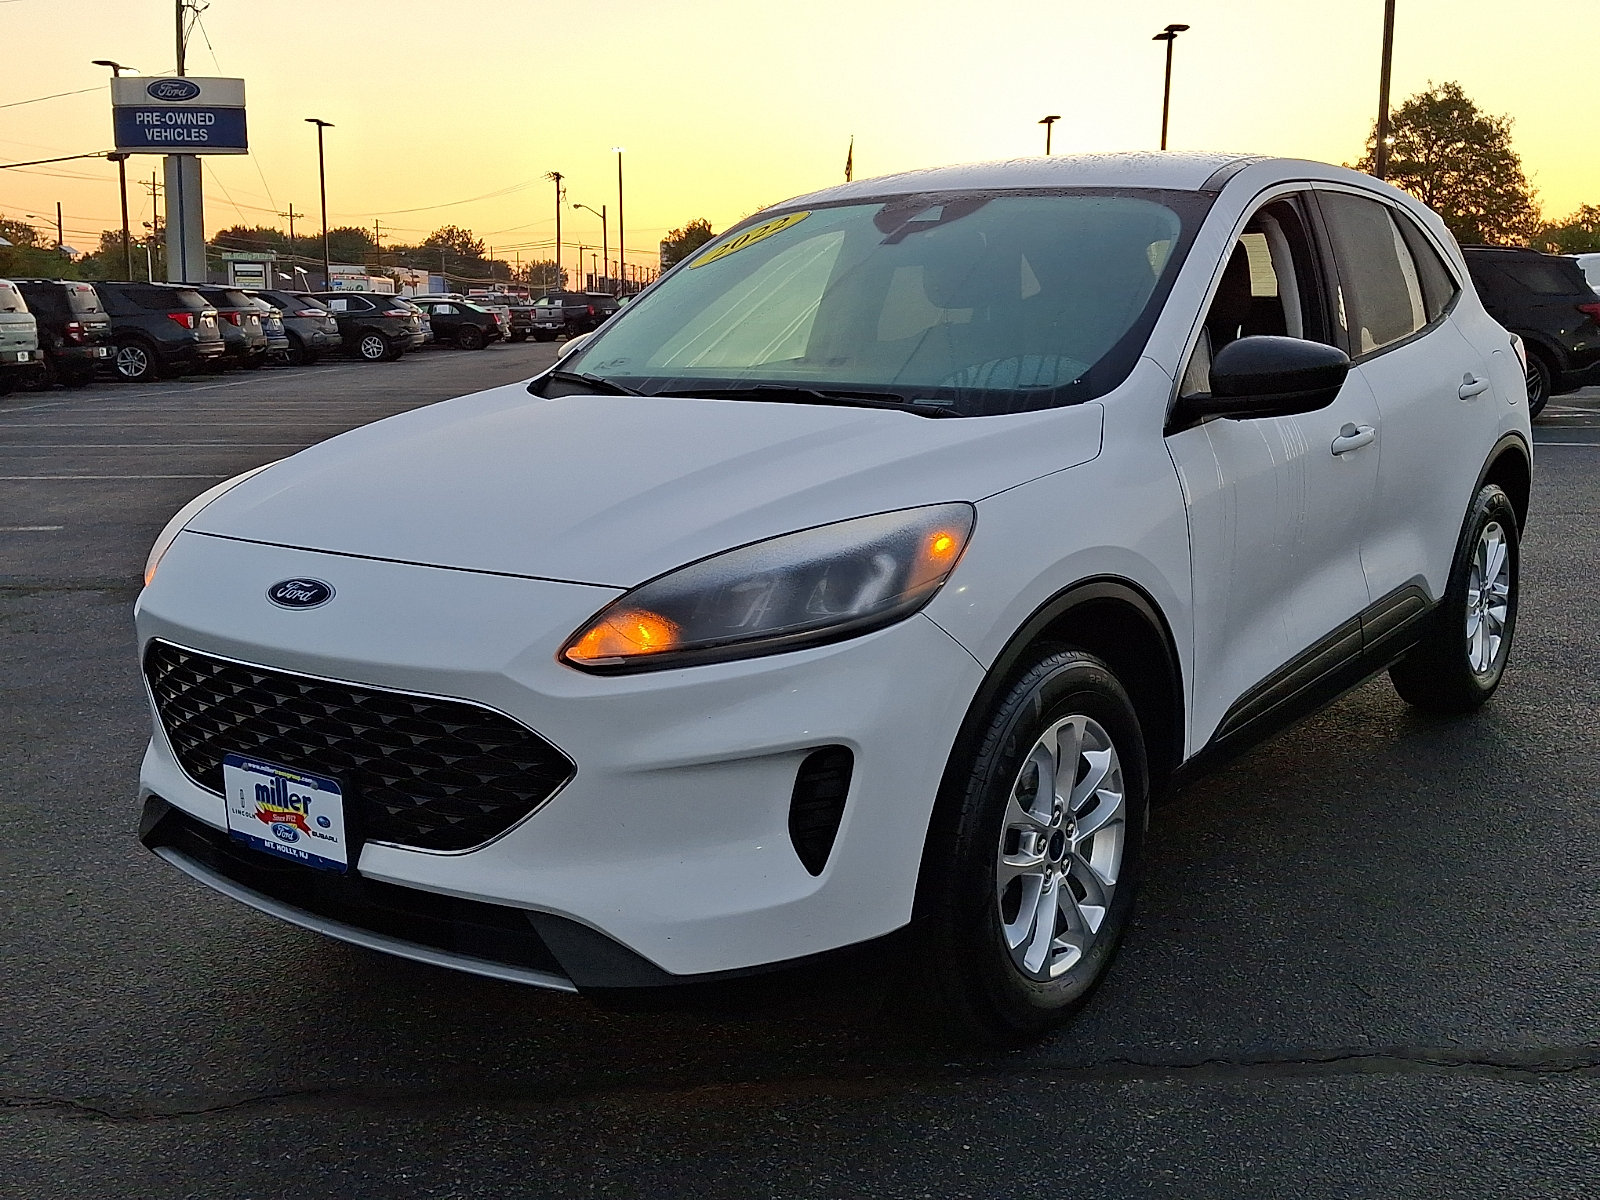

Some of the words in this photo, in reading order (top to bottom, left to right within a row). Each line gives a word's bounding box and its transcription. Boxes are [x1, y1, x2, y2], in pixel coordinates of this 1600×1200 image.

[157, 82, 188, 97] Ford
[135, 112, 216, 126] PRE-OWNED
[145, 128, 208, 141] VEHICLES
[709, 216, 791, 260] 2022
[276, 581, 318, 601] Ford
[255, 776, 312, 815] miller
[231, 807, 257, 819] LINCOLN
[276, 824, 294, 841] Ford
[311, 830, 338, 844] SUBARU
[276, 843, 298, 858] HOLLY,
[299, 850, 309, 860] NJ
